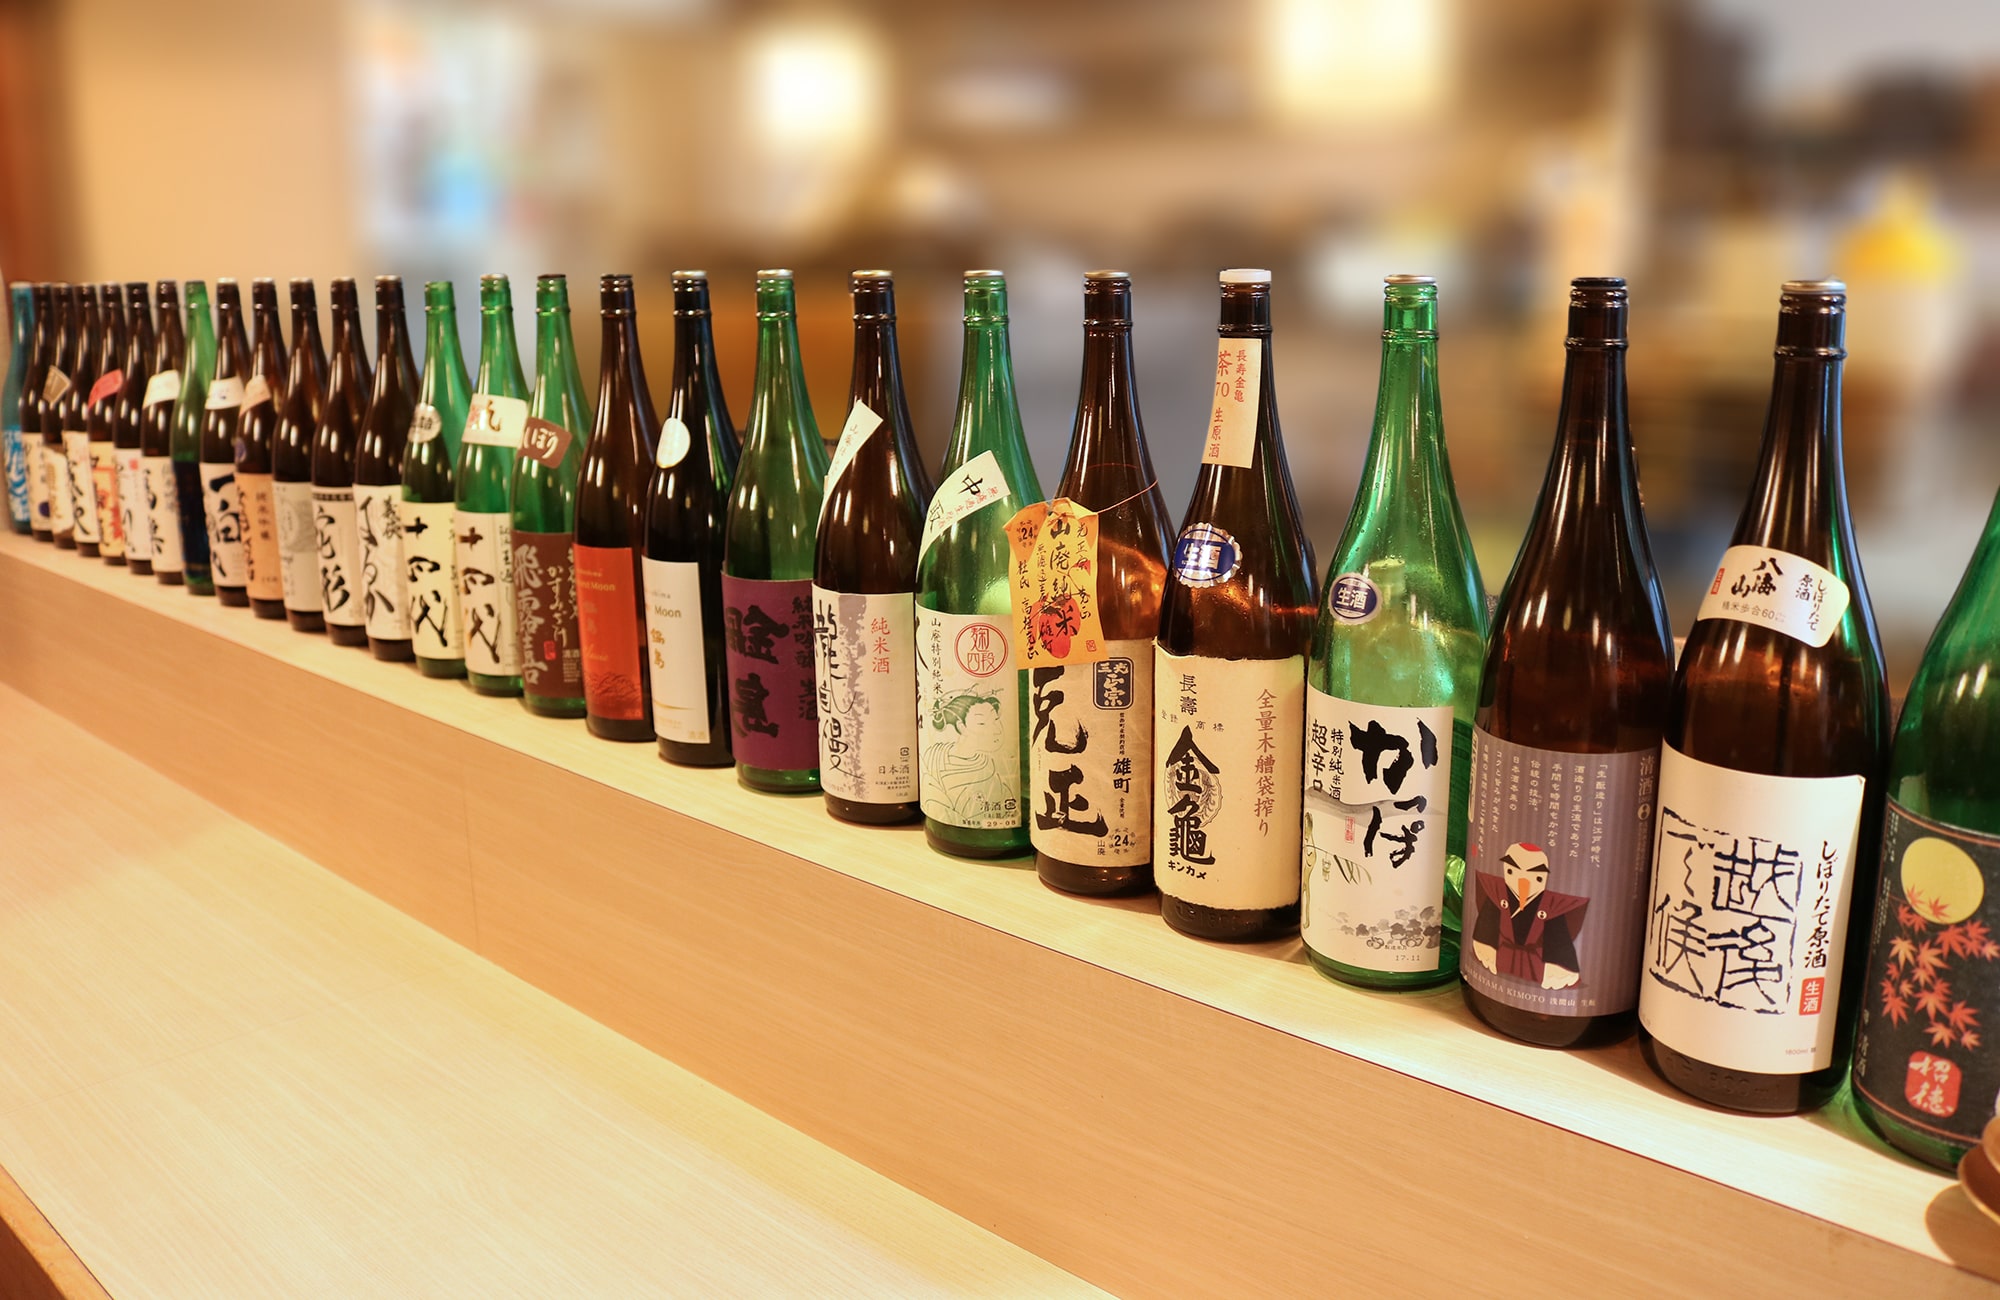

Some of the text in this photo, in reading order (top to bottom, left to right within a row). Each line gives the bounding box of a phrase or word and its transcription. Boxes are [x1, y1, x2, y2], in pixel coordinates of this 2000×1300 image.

[1234, 349, 1247, 402] 長寿金亀
[1208, 407, 1224, 459] 生原酒
[1021, 527, 1034, 540] 24
[1182, 542, 1221, 570] 生酒
[404, 517, 448, 648] 十四代
[459, 526, 501, 665] 十四代
[1050, 518, 1078, 638] 山廃純米
[1730, 556, 1784, 598] 八海山
[1795, 574, 1814, 602] 原酒
[654, 604, 682, 618] Moon
[1336, 587, 1368, 608] 生酒
[1807, 578, 1828, 631] しぼりたて
[870, 616, 891, 675] 純米酒
[878, 764, 910, 775] 日本酒
[1311, 718, 1330, 793] 超辛口
[1328, 728, 1344, 801] 特別純米酒
[1113, 757, 1131, 794] 雄町
[980, 801, 1001, 813] 清酒
[986, 819, 1017, 828] 29-08
[1547, 763, 1562, 848] 手間も時間もかかる
[1569, 765, 1585, 858] 酒造りの主流であった
[1114, 834, 1129, 847] 24
[1167, 860, 1208, 880] キンカメ
[1804, 839, 1837, 970] しぼりたて原酒
[1507, 988, 1545, 1003] KIMOTO
[1802, 980, 1820, 1013] 生酒
